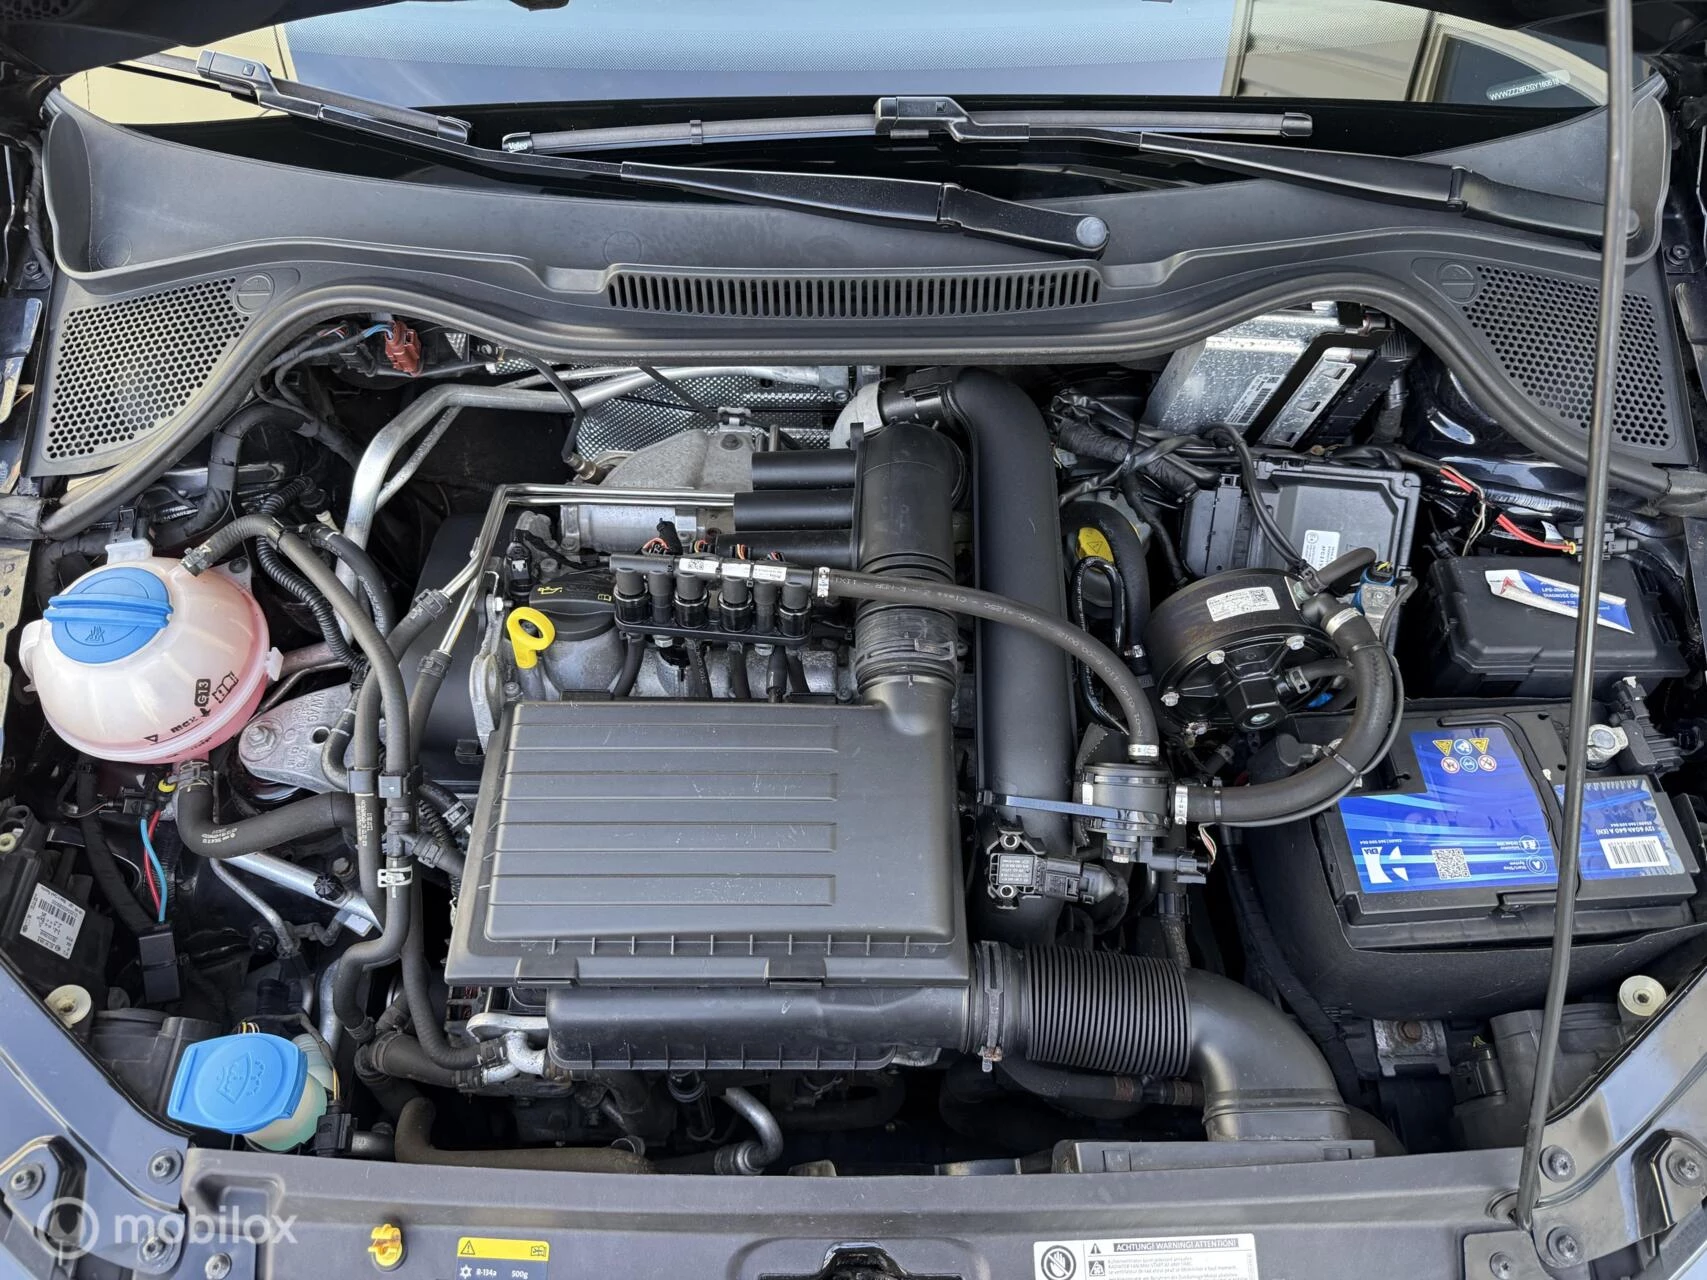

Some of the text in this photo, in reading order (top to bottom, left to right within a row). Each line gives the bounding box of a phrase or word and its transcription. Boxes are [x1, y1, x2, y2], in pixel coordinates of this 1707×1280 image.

[507, 141, 529, 153] Valeo
[196, 680, 210, 704] G13
[170, 716, 199, 734] max
[1363, 847, 1379, 855] ERA
[1116, 1239, 1237, 1252] ACHTUNG! WARNING! ATTENTION!
[511, 1270, 529, 1280] 500g
